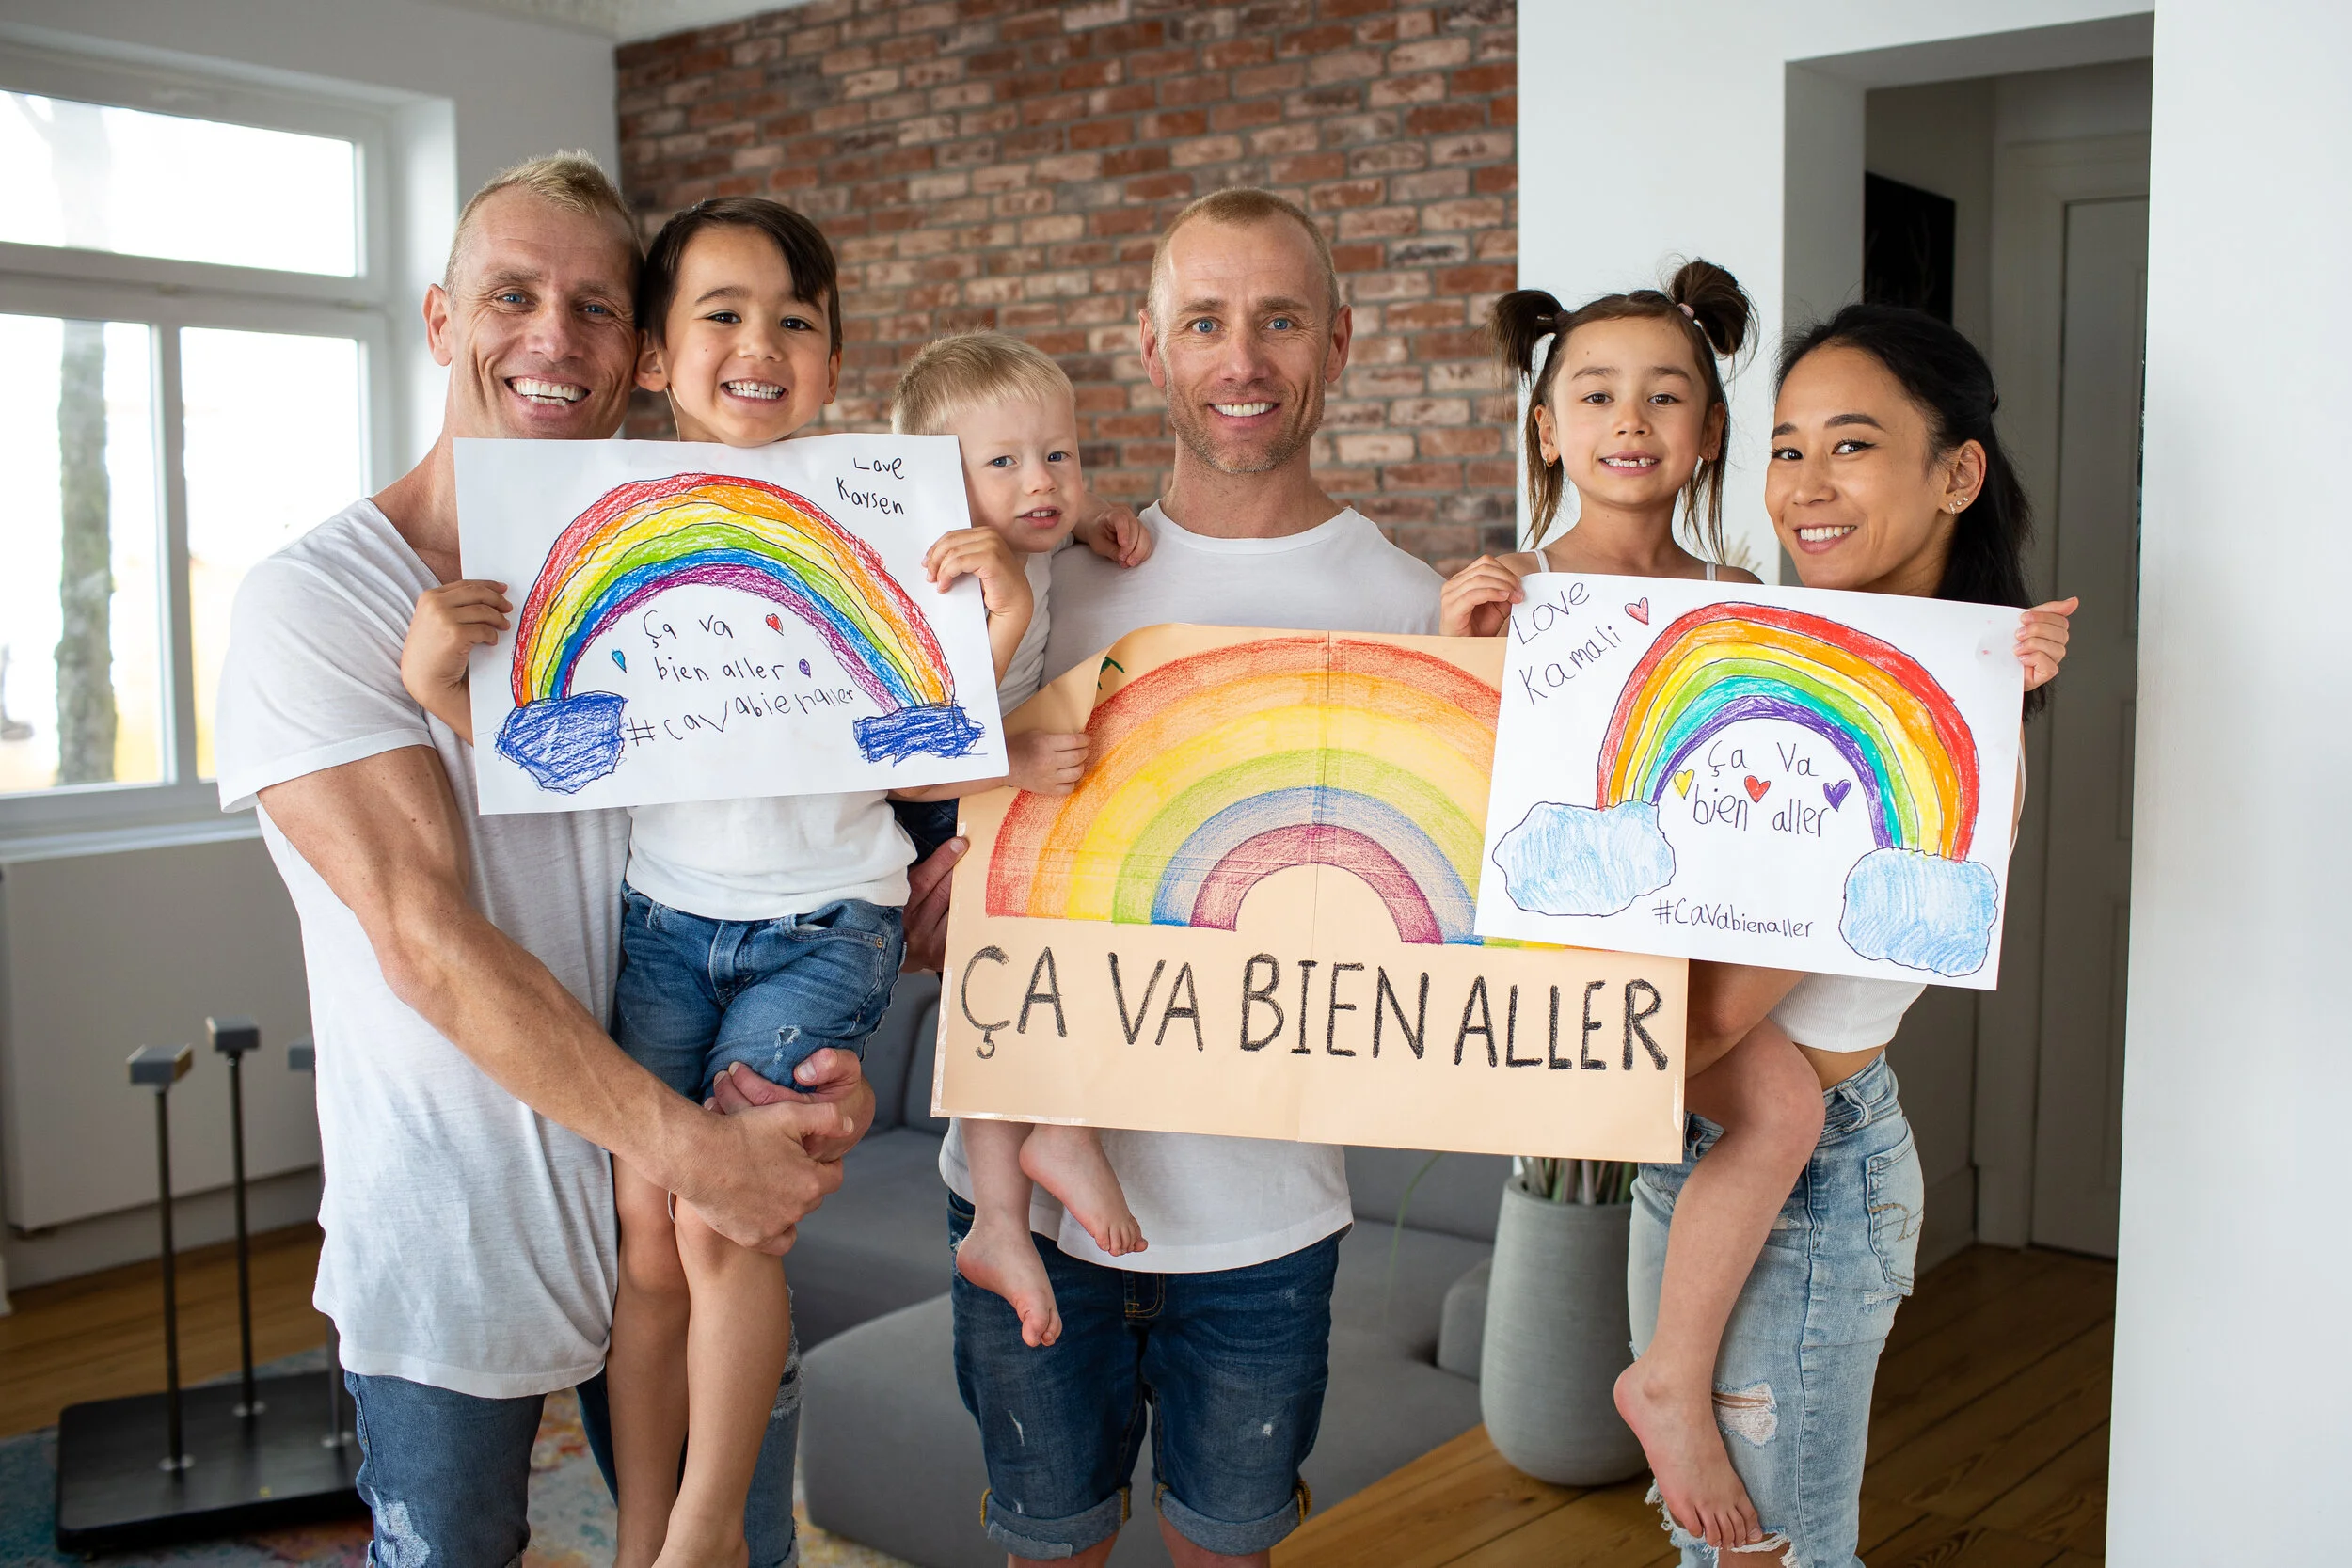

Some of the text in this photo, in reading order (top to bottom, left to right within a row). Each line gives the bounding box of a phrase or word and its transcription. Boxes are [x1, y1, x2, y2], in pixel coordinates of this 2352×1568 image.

[853, 457, 904, 480] Love
[836, 477, 904, 515] Kaysen
[644, 610, 677, 649] Ça
[654, 656, 785, 683] bien aller
[1518, 626, 1622, 705] Kamali
[1708, 740, 1750, 777] Ça
[1692, 784, 1829, 837] bien aller
[961, 944, 1670, 1072] ÇA VA BIEN ALLER
